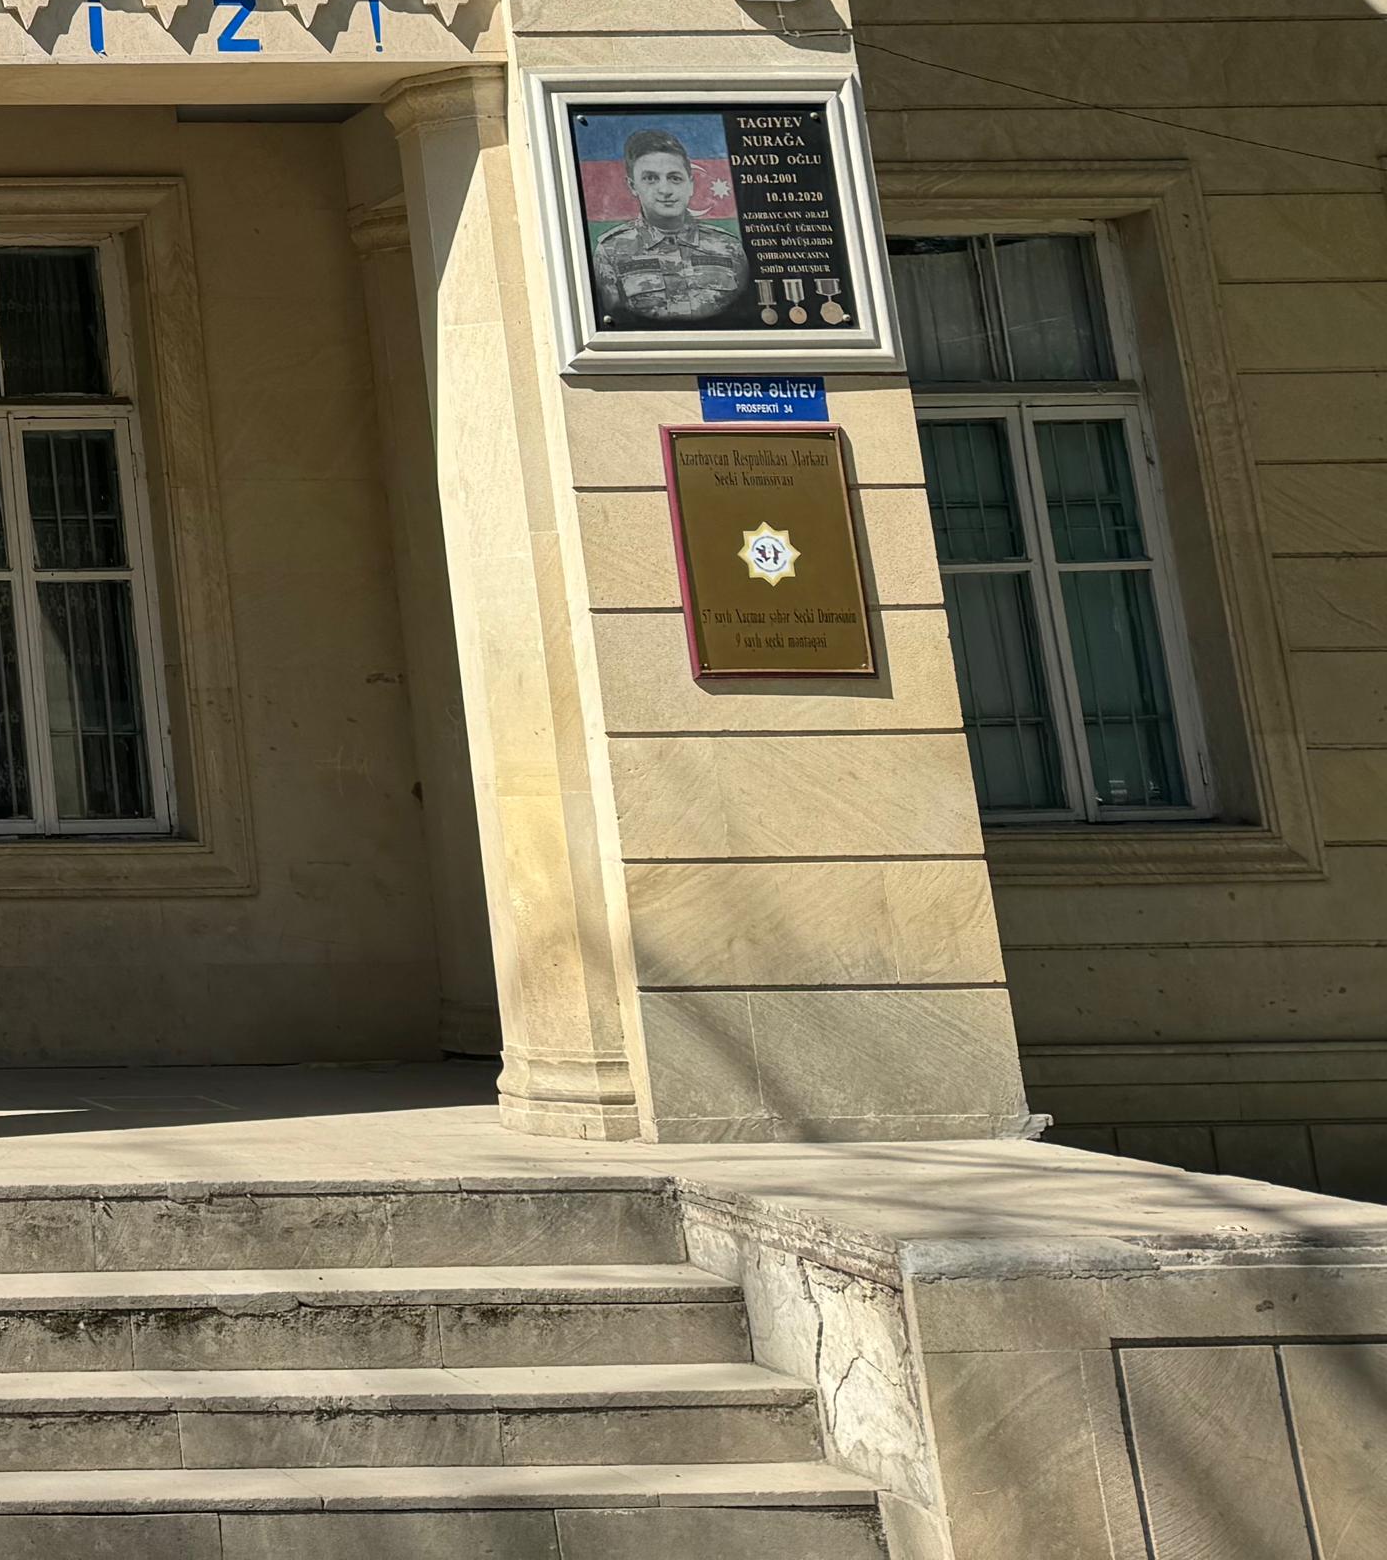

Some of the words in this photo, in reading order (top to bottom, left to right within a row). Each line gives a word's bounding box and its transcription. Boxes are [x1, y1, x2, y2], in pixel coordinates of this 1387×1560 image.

[742, 132, 805, 146] NURAĞA
[730, 154, 779, 166] DAVUD
[787, 153, 821, 165] OĞLU
[740, 173, 797, 184] 20.04.2001
[765, 192, 823, 202] 10.10.2020
[707, 382, 763, 398] HEYDƏR
[769, 380, 816, 398] ƏLİYEV
[735, 402, 779, 414] PROSPEKTİ
[784, 404, 793, 413] 34
